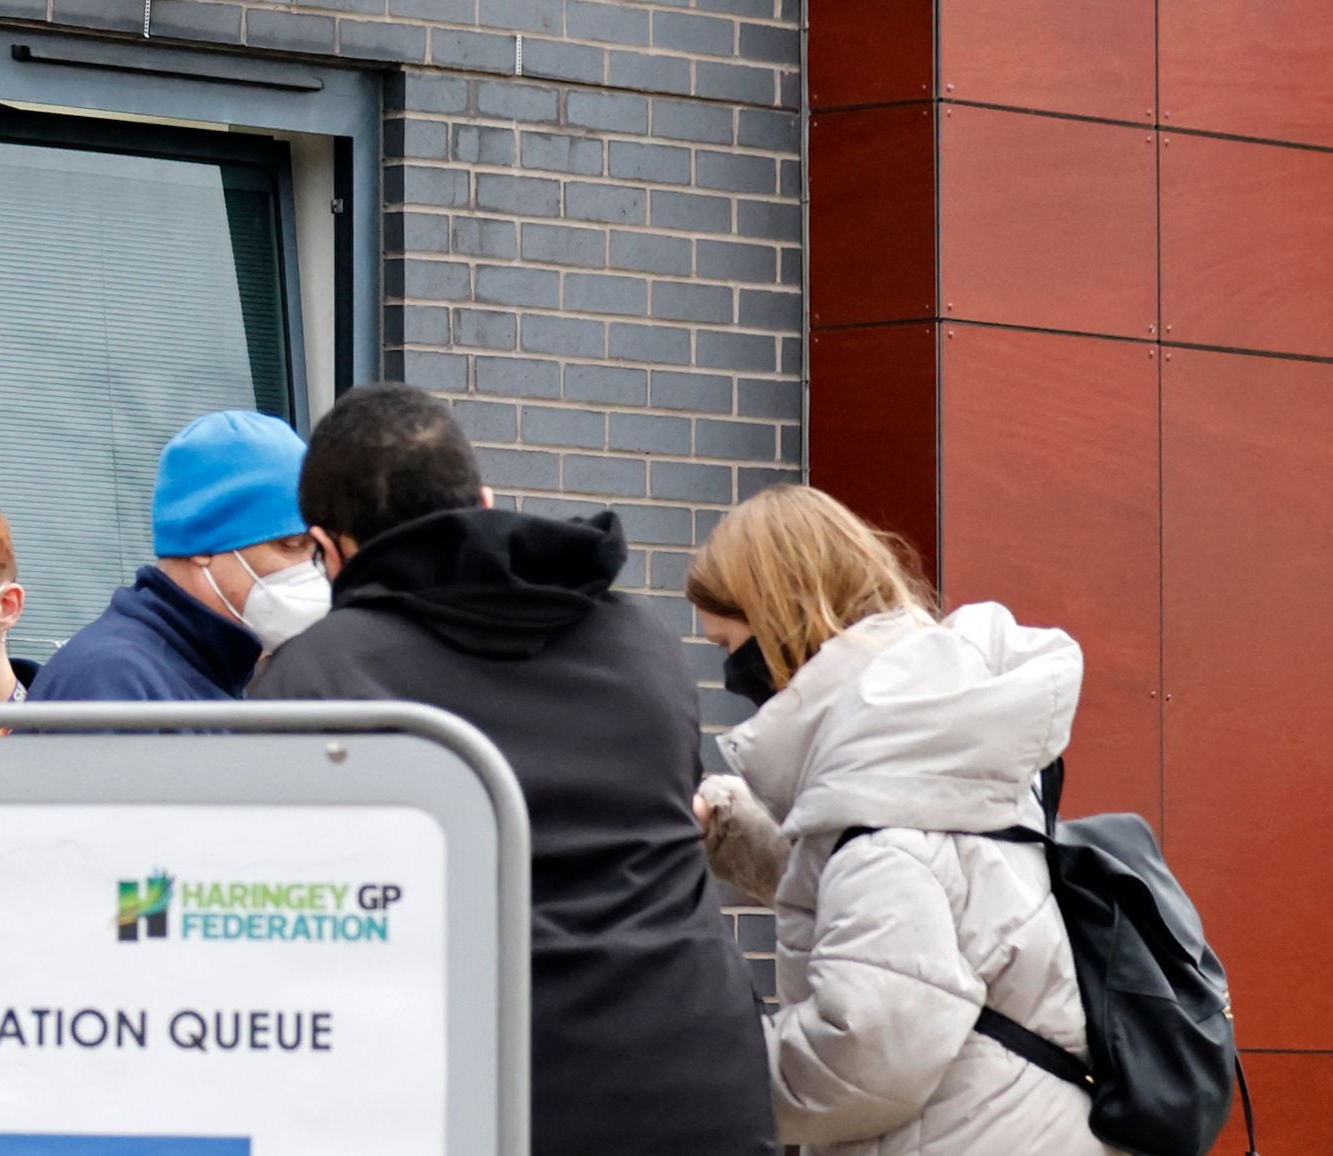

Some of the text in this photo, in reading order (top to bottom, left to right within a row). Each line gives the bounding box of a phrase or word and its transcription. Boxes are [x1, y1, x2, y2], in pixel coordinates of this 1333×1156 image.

[182, 880, 402, 911] HARINGEY GP
[182, 911, 390, 942] FEDERATION
[168, 1009, 334, 1052] QUEUE
